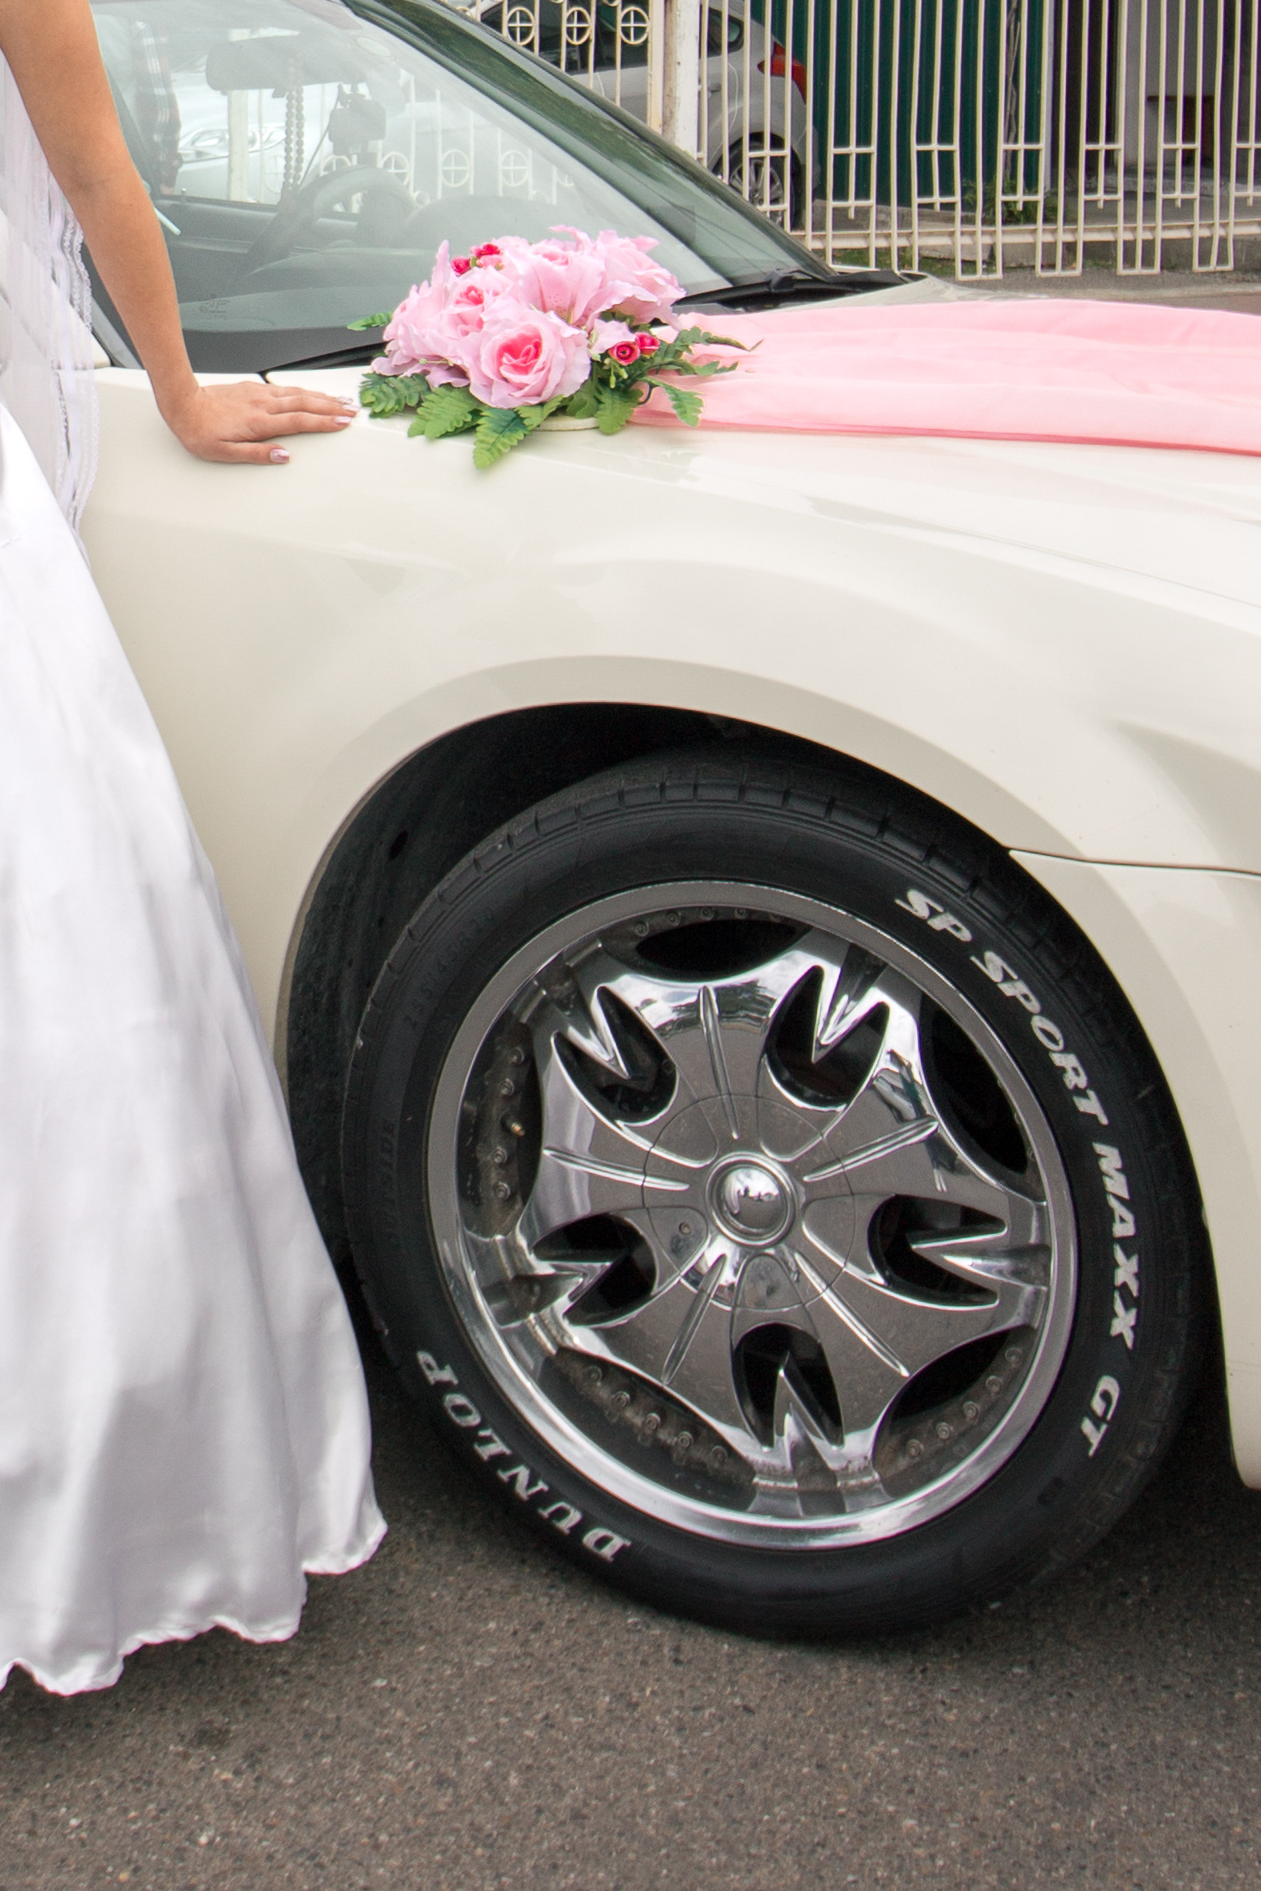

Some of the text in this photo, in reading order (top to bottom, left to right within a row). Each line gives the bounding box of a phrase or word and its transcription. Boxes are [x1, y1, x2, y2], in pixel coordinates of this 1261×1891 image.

[893, 888, 1140, 1457] SP SPORT MAXX GT
[416, 1349, 633, 1564] DUNLOP
